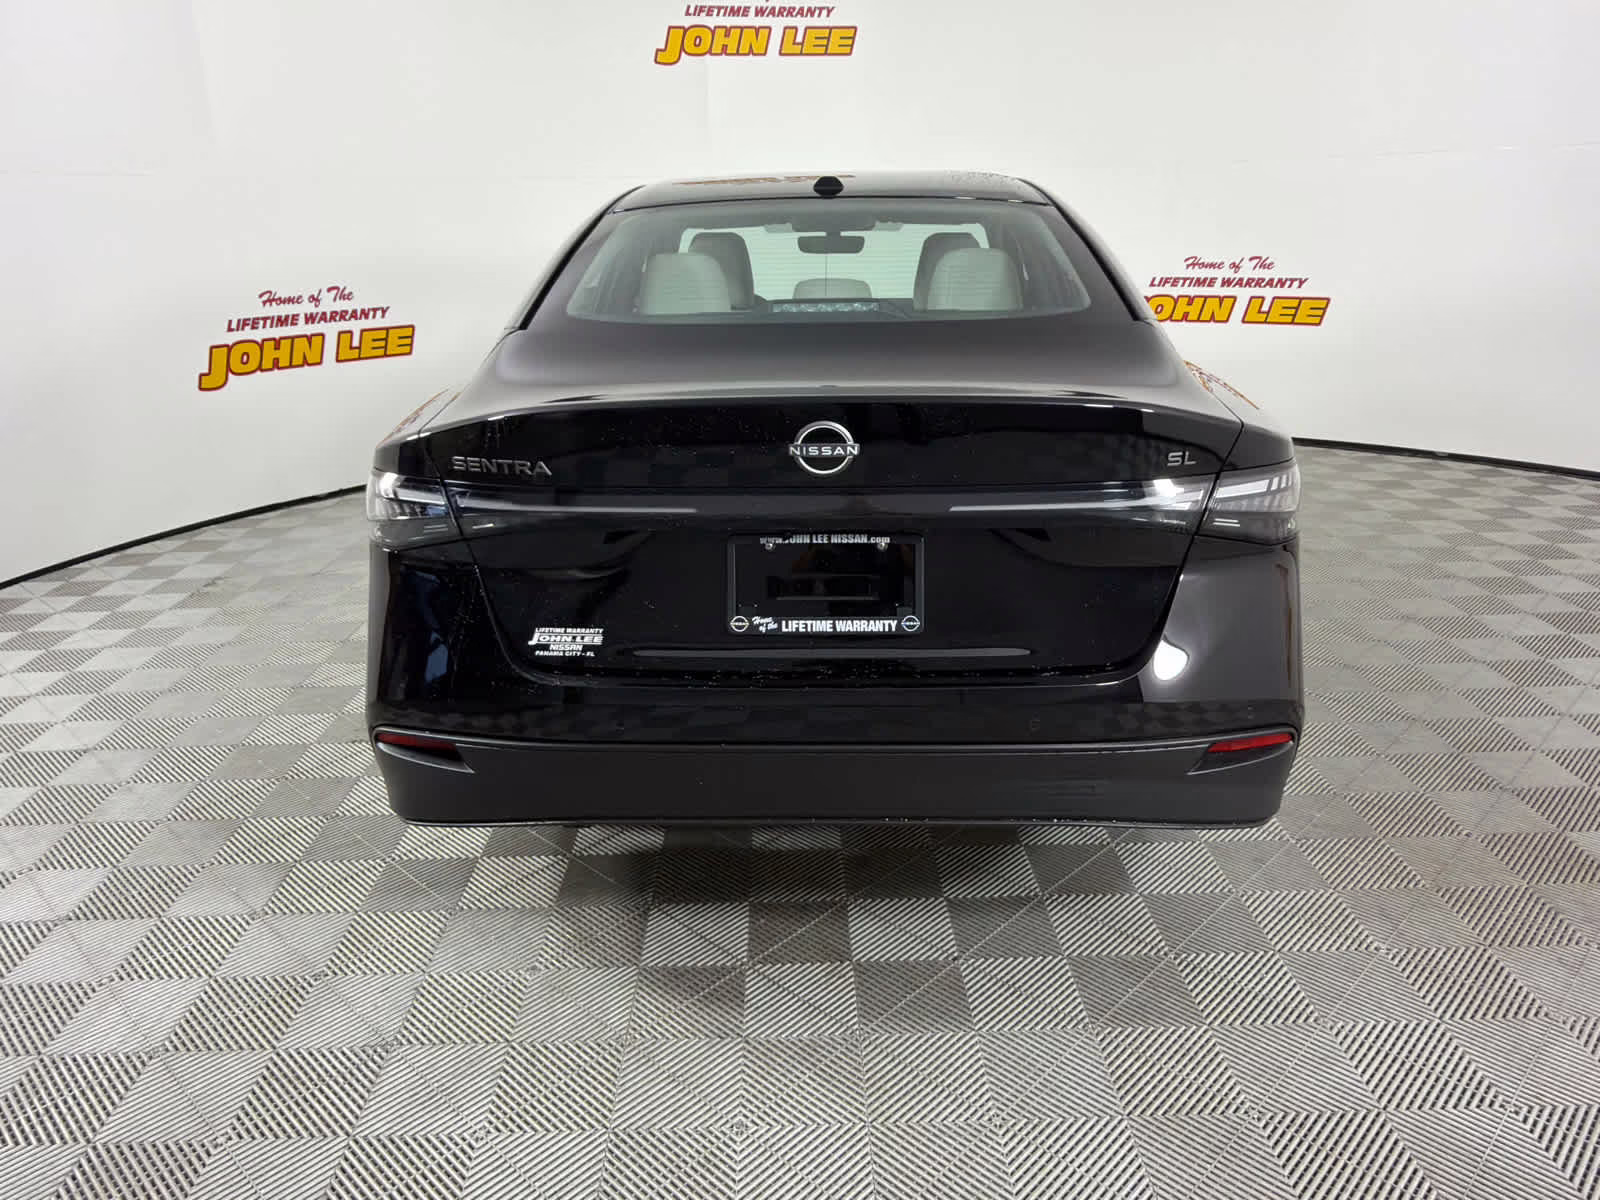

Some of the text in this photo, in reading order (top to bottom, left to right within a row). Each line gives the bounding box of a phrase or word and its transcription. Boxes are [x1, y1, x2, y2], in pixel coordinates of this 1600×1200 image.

[684, 5, 835, 18] LIFETIME WARRANTY
[654, 24, 857, 66] JOHN LEE
[1184, 256, 1275, 274] Home of The
[1149, 277, 1308, 289] LIFETIME WARRANTY
[258, 285, 354, 308] Home of The
[1144, 294, 1331, 326] OHN LEE
[226, 306, 390, 333] LIFETIME WARRANTY
[198, 324, 415, 391] JOHN LEE
[789, 445, 859, 456] NISSAN
[1167, 451, 1197, 466] SL
[451, 456, 552, 475] SENTRA
[812, 534, 829, 544] LEE
[781, 620, 833, 632] LIFETIME
[835, 620, 898, 632] WARRANTY
[528, 632, 604, 645] JOHN LEE
